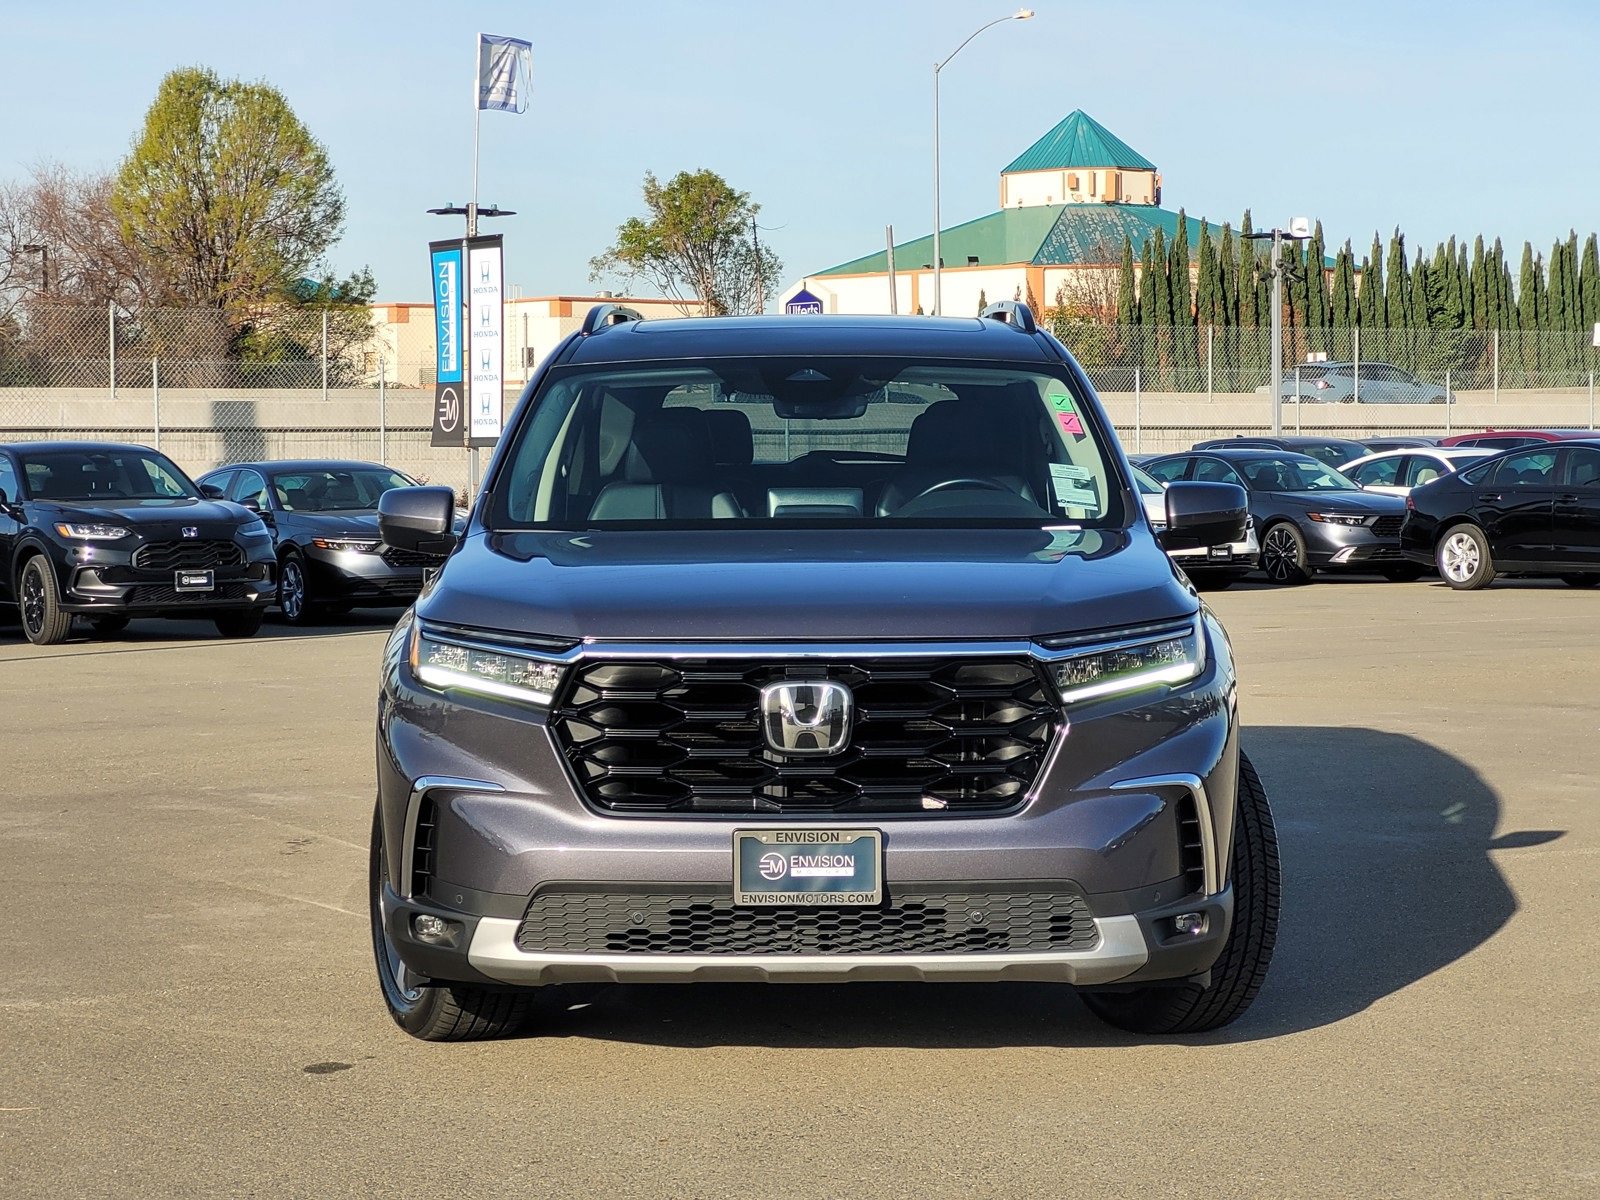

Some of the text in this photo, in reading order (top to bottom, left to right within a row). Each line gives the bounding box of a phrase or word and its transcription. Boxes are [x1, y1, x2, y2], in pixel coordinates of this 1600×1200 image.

[480, 86, 518, 98] HOND
[473, 286, 499, 294] HONDA
[438, 262, 450, 372] ENVISION
[473, 330, 499, 338] HONDA
[473, 374, 499, 382] HONDA
[473, 418, 499, 426] HONDA
[775, 832, 840, 843] ENVISION
[790, 855, 855, 867] ENVISION
[741, 894, 875, 904] ENVISIONMOTORS.COM
